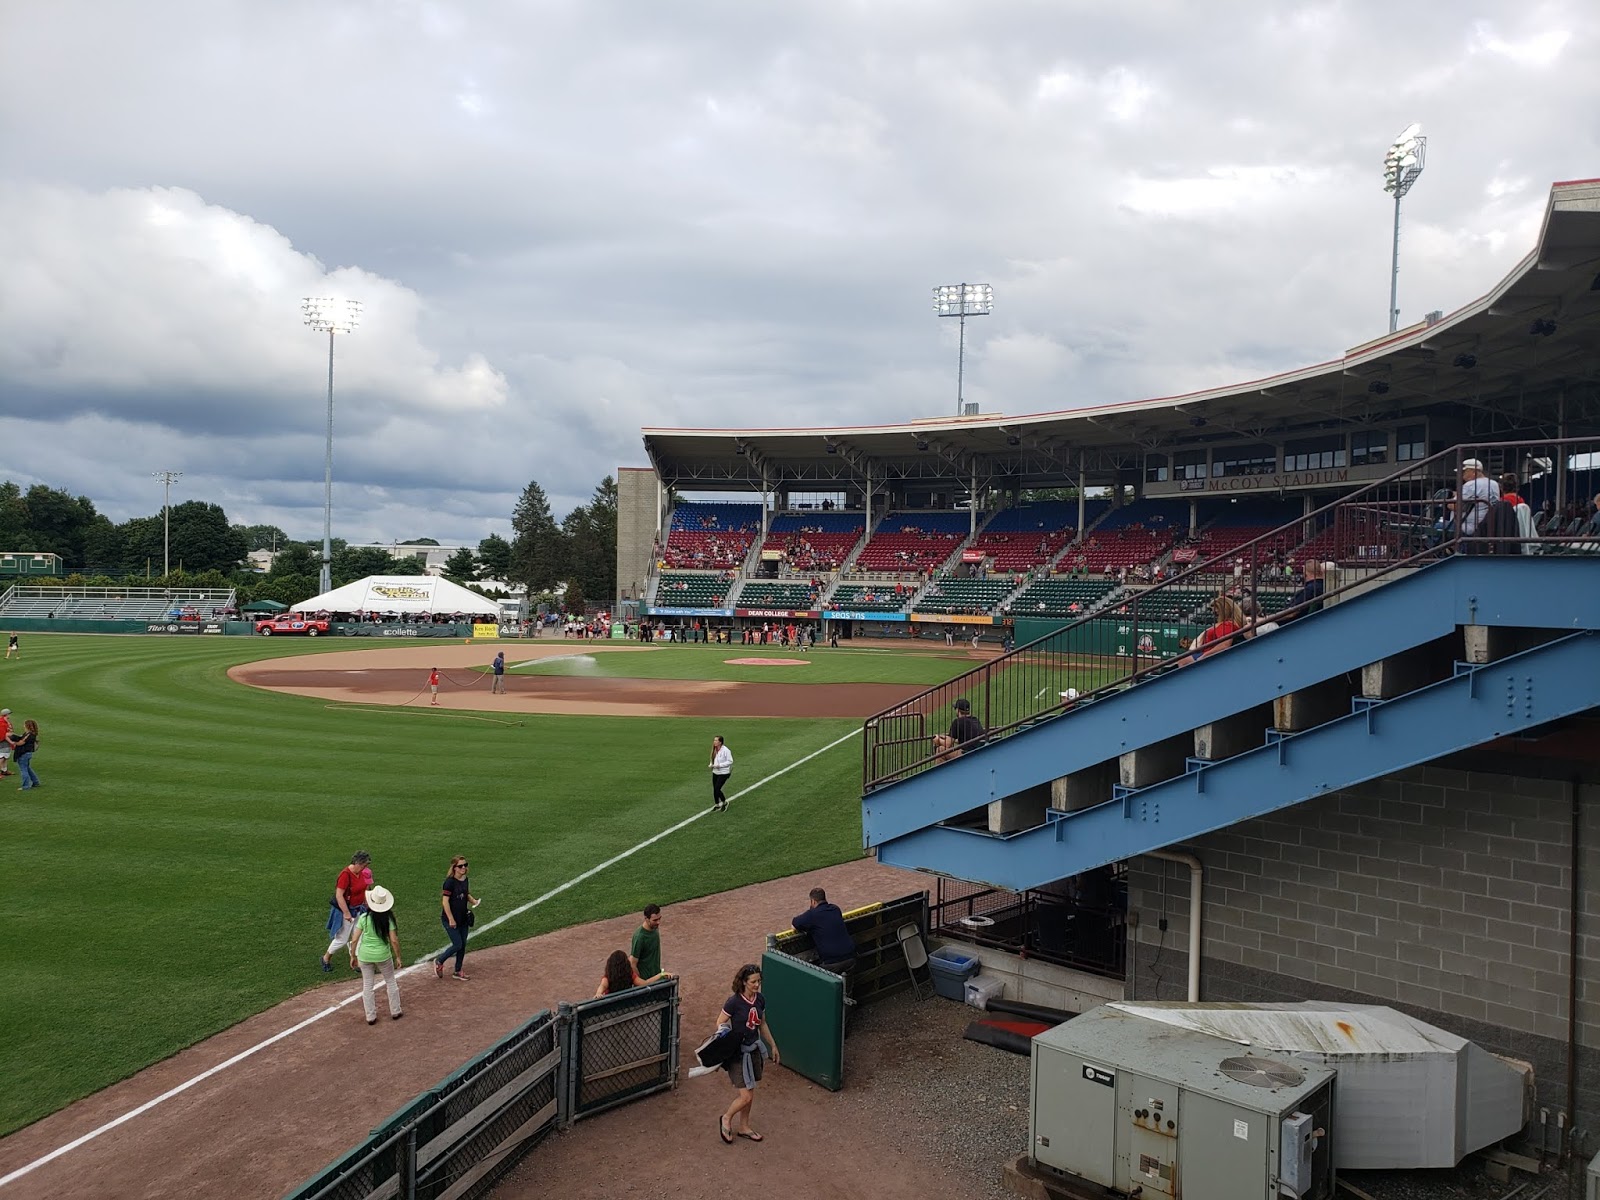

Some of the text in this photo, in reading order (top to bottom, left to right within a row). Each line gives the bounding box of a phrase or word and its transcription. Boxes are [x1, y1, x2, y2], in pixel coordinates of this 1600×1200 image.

[1209, 477, 1263, 491] McCOY
[1273, 470, 1348, 486] STADIUM
[372, 586, 421, 596] Quality
[389, 628, 418, 636] collette
